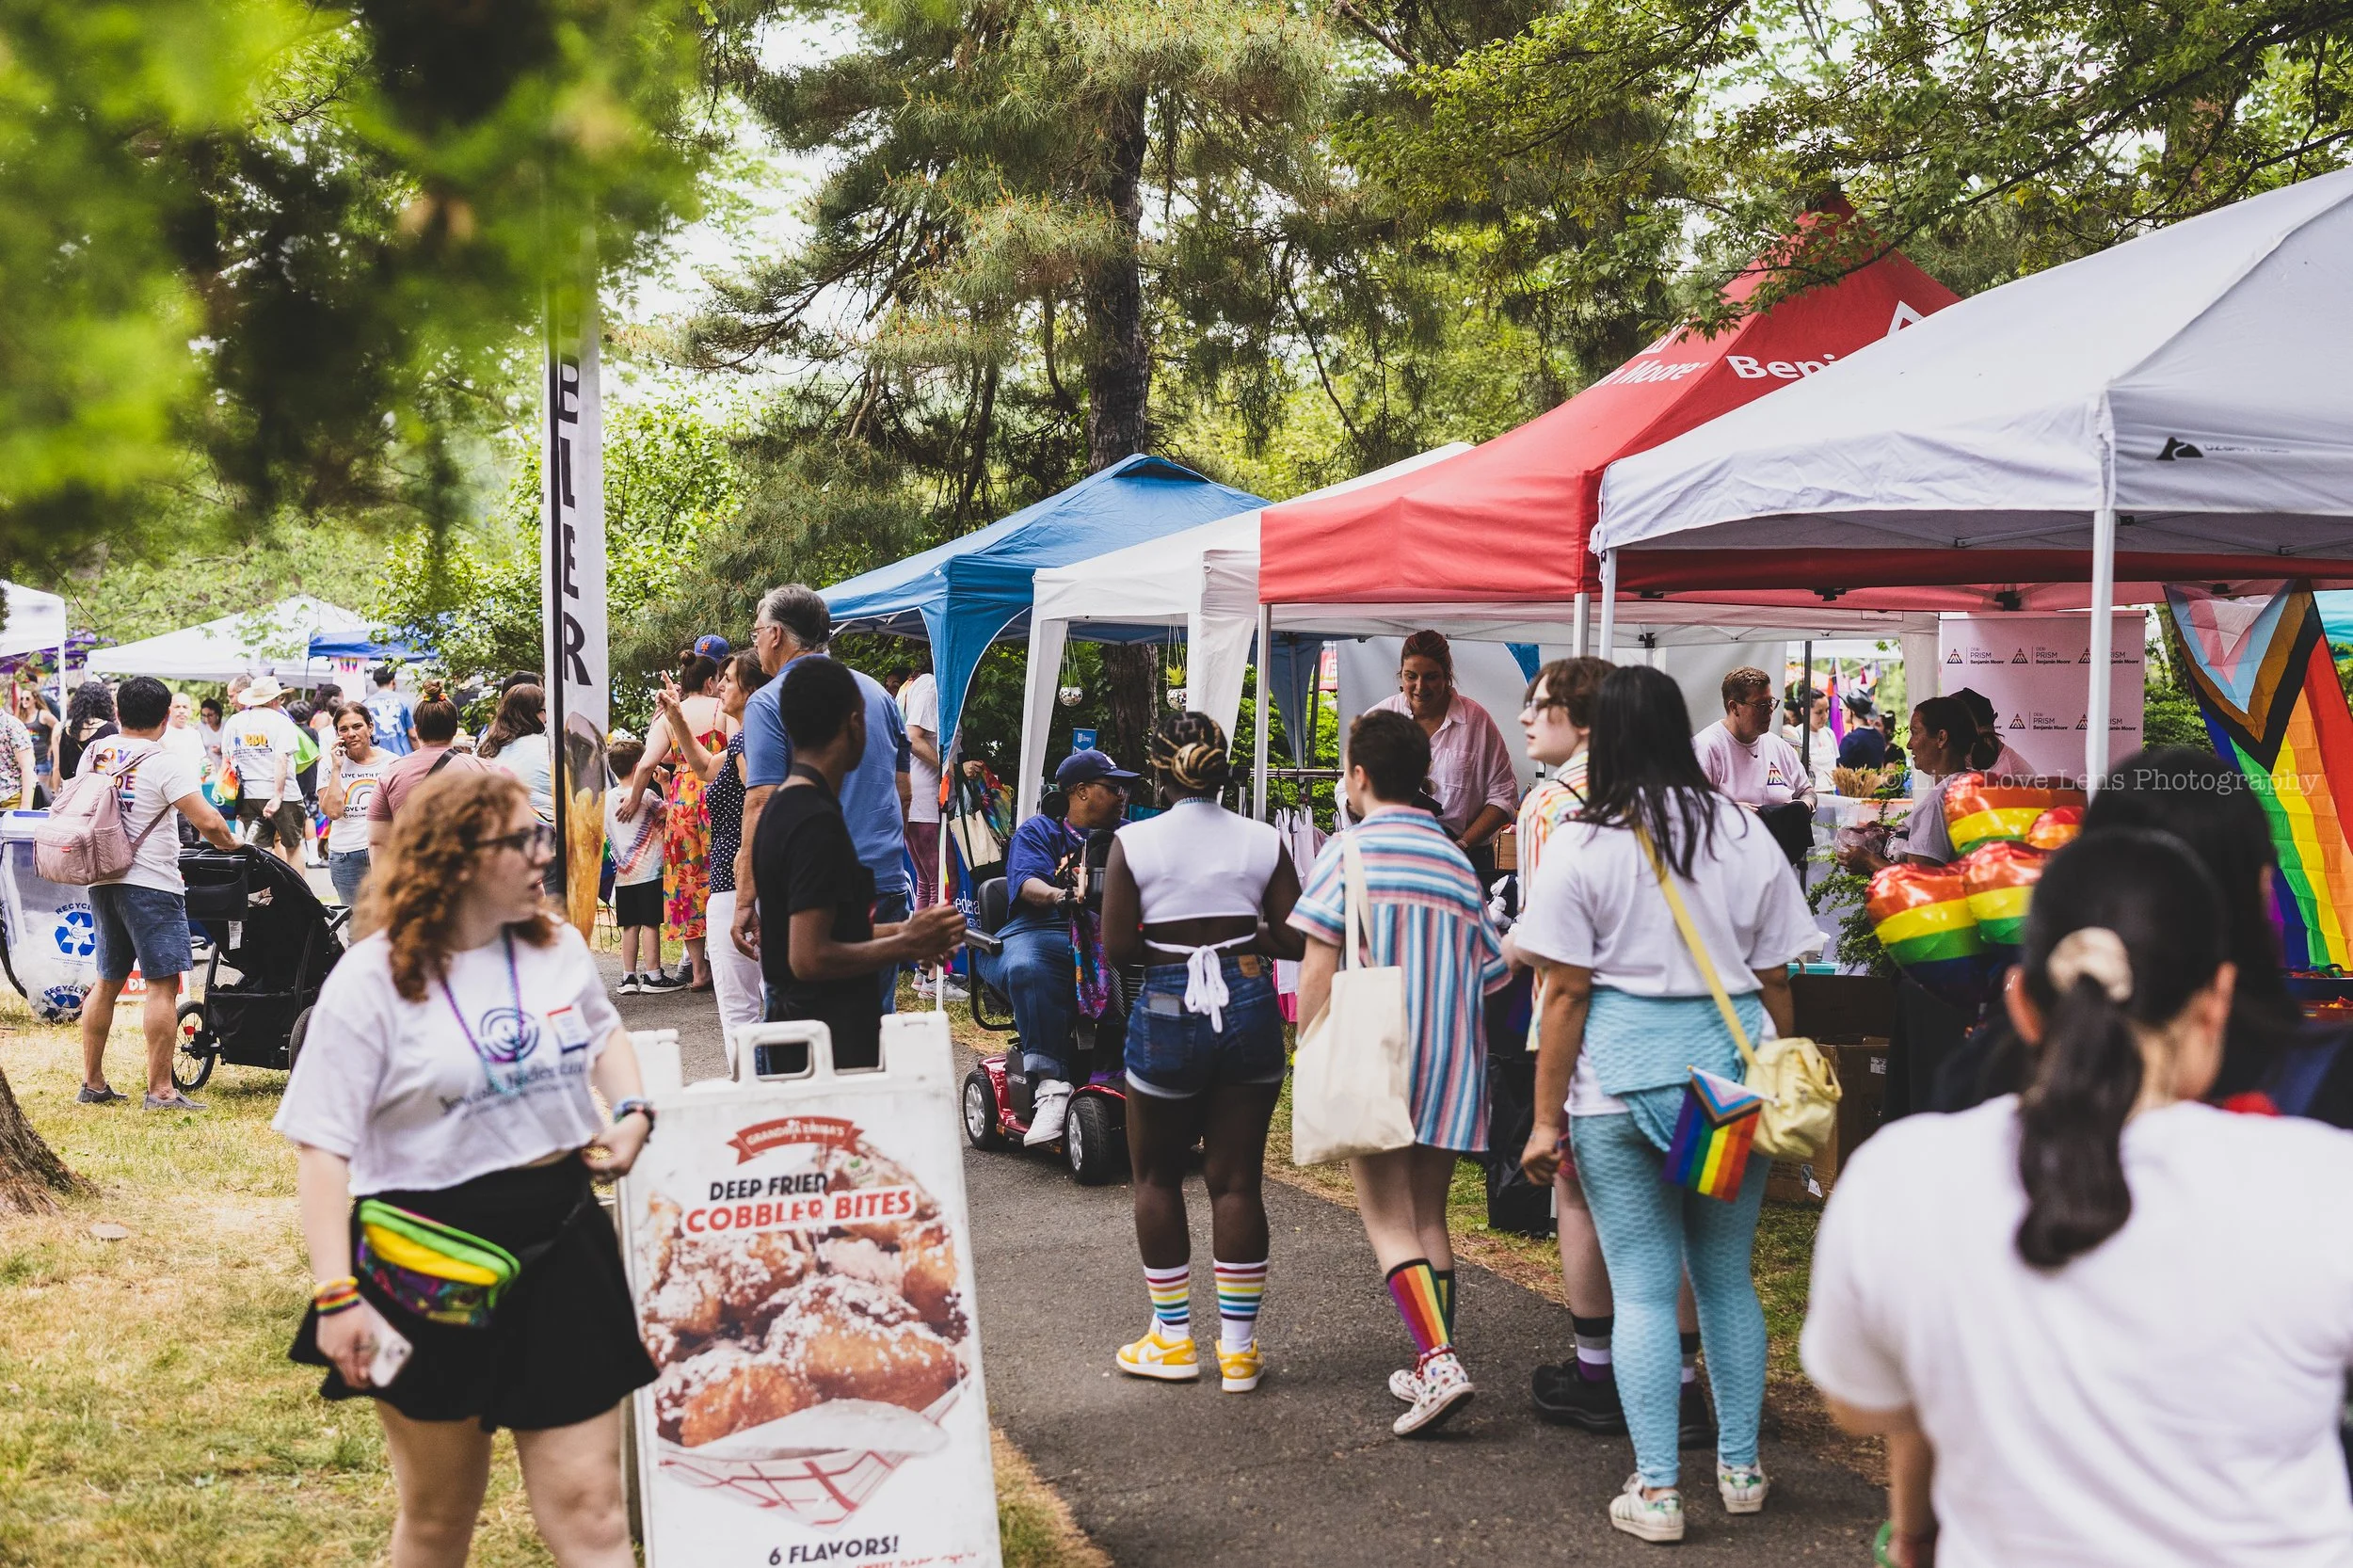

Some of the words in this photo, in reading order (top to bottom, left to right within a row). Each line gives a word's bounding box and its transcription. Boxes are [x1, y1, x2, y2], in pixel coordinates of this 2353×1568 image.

[55, 903, 91, 915] RECYCL
[43, 984, 88, 998] RECYCLIN
[710, 1178, 762, 1201] DEEP
[769, 1173, 827, 1195] FRIED
[686, 1199, 824, 1233] COBBLER
[835, 1190, 911, 1220] BITES
[768, 1547, 781, 1566] 6
[789, 1535, 899, 1563] FLAVORS!
